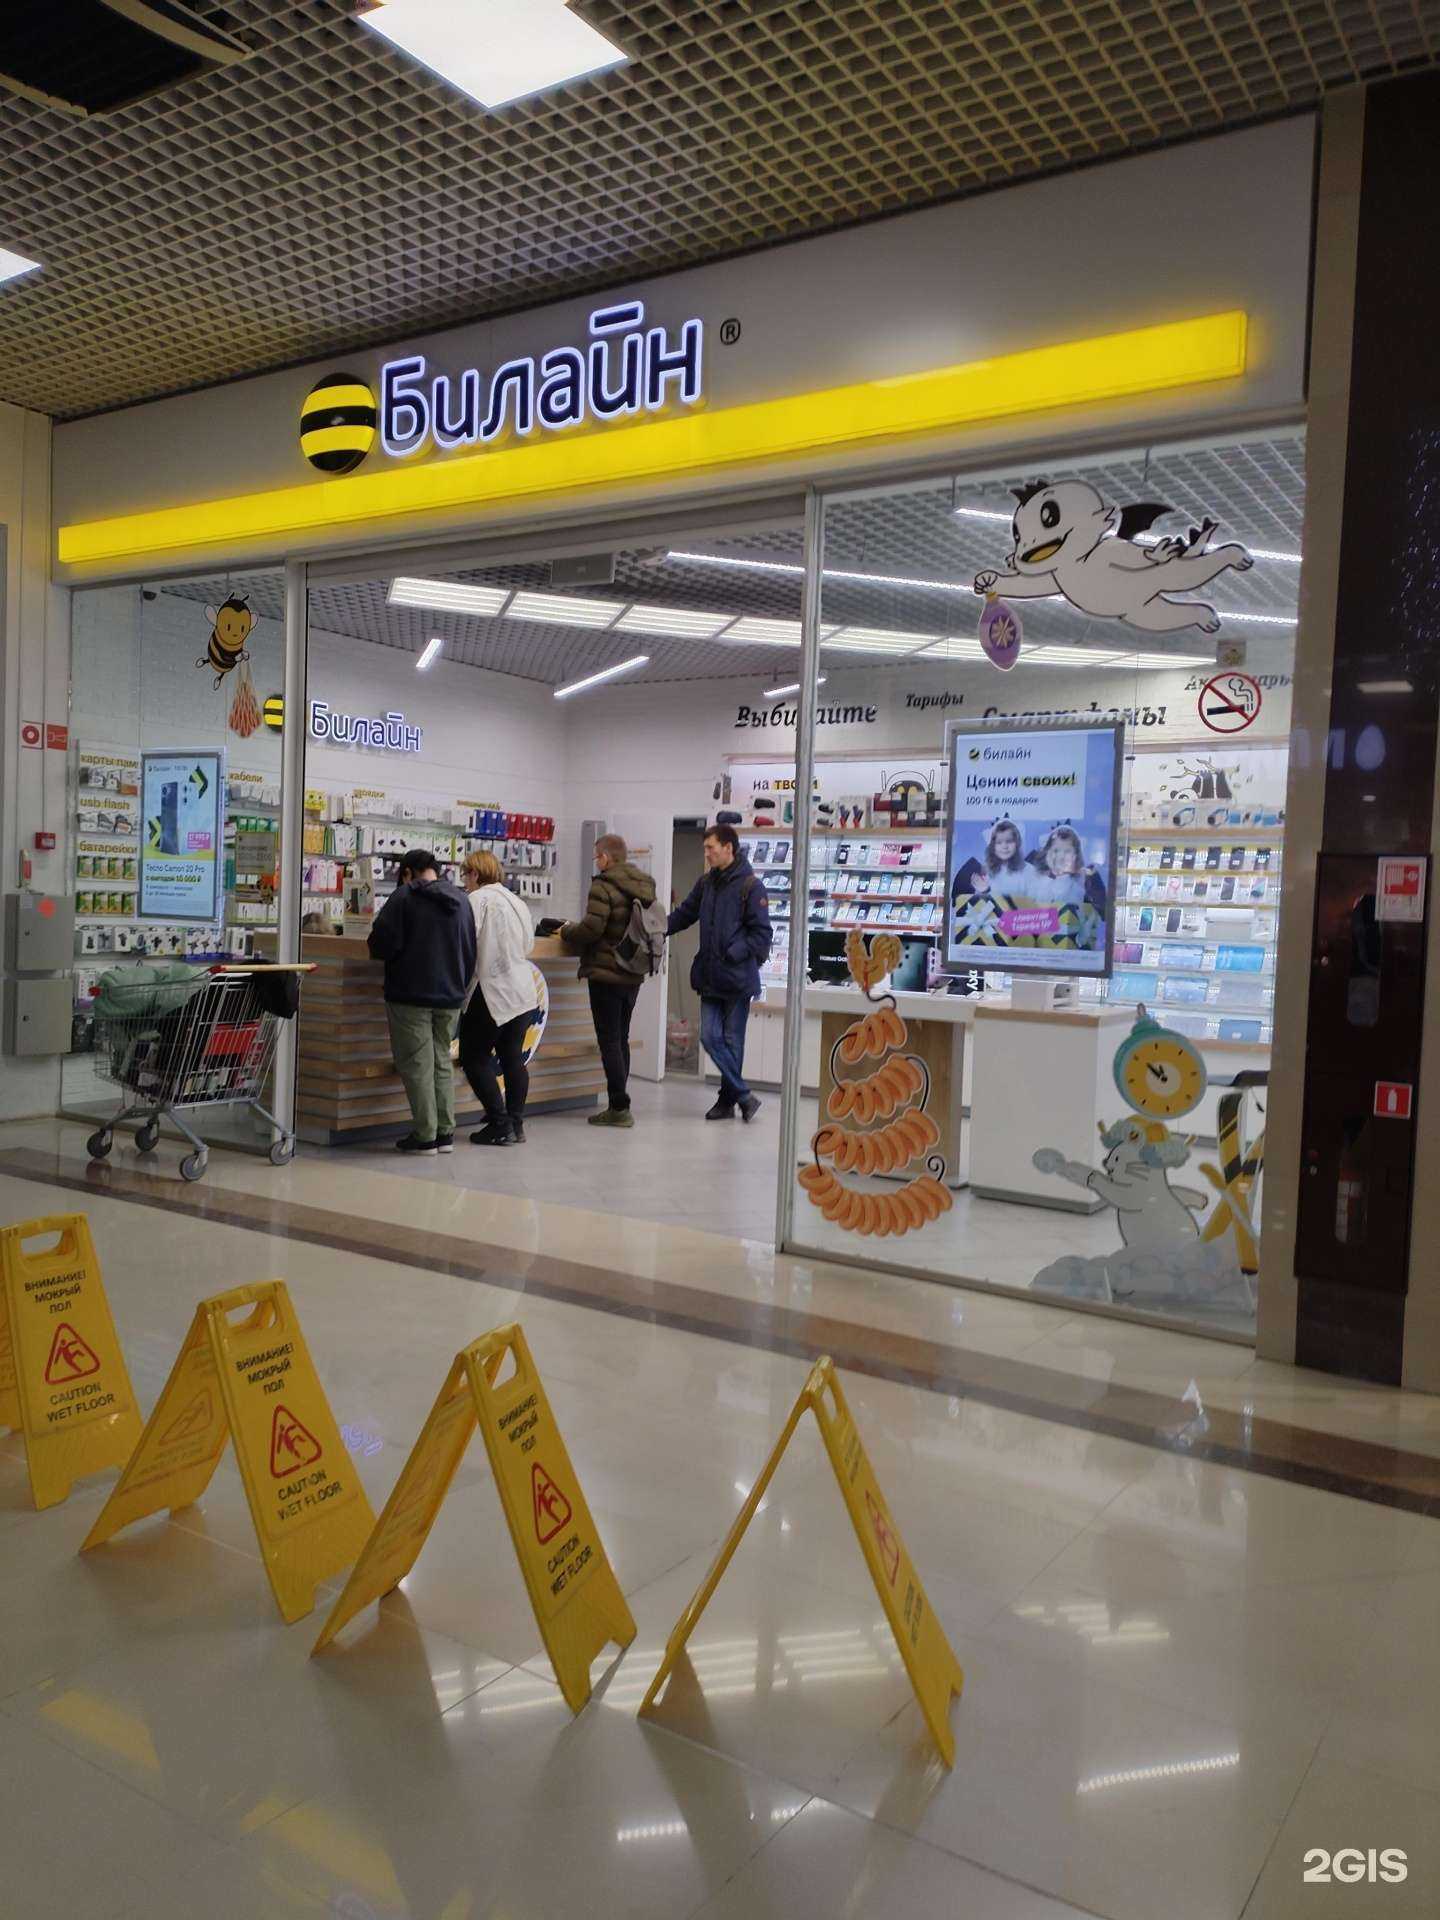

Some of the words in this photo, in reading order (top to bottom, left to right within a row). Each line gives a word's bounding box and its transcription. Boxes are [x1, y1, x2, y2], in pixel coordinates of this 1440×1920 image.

[382, 302, 703, 457] Билайн
[905, 692, 965, 711] Тарифы
[311, 701, 422, 751] Билайн
[734, 701, 879, 729] Выбиайте
[983, 747, 1032, 760] билайн
[753, 779, 769, 791] на
[966, 774, 1018, 789] Ценим
[1022, 772, 1077, 787] своих!
[80, 796, 101, 809] usb
[104, 797, 130, 810] flash
[25, 1270, 86, 1292] ВНИМАНИЕ!
[35, 1283, 81, 1303] МОКРЫЙ
[50, 1302, 72, 1313] ПОЛ
[236, 1343, 294, 1372] ВНИМАНИЕ!
[248, 1359, 292, 1384] МОКРЫЙ
[50, 1382, 102, 1405] CAUTION
[264, 1379, 285, 1395] ПОЛ
[47, 1406, 72, 1422] WET
[76, 1393, 115, 1414] FLOOR
[278, 1470, 327, 1500] CAUTION
[278, 1501, 302, 1520] WET
[305, 1481, 342, 1507] FLOOR
[548, 1533, 581, 1574] CAUTION
